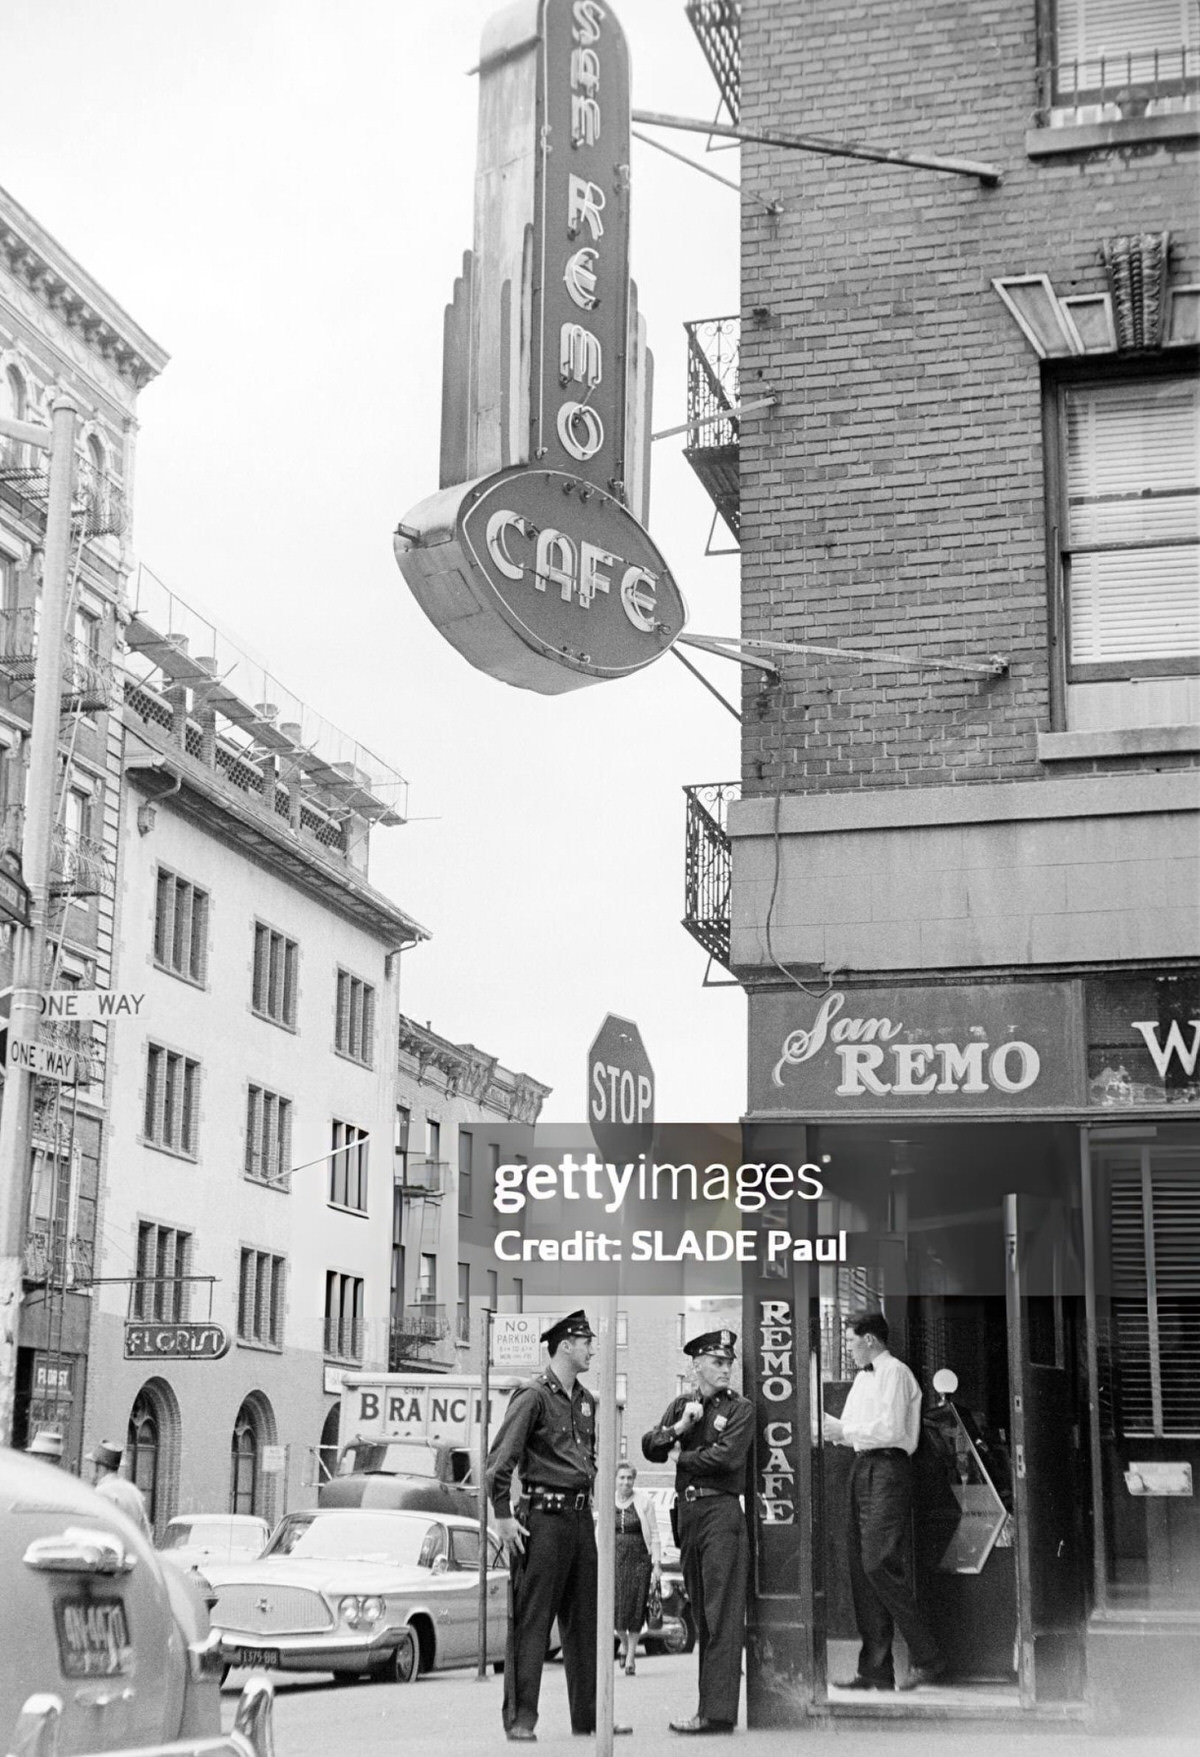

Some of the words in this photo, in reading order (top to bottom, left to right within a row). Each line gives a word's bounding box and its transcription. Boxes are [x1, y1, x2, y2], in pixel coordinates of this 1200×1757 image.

[555, 172, 605, 462] REMO
[485, 509, 661, 633] CAFE
[98, 993, 146, 1016] WAY
[11, 1040, 36, 1068] ONE
[46, 1050, 72, 1077] WAY
[771, 992, 903, 1088] San
[835, 1040, 1041, 1097] REMO
[592, 1061, 653, 1125] STOP
[496, 1333, 537, 1345] PARKING
[505, 1320, 529, 1332] NO
[759, 1300, 794, 1402] REMO
[760, 1421, 796, 1525] CAFE
